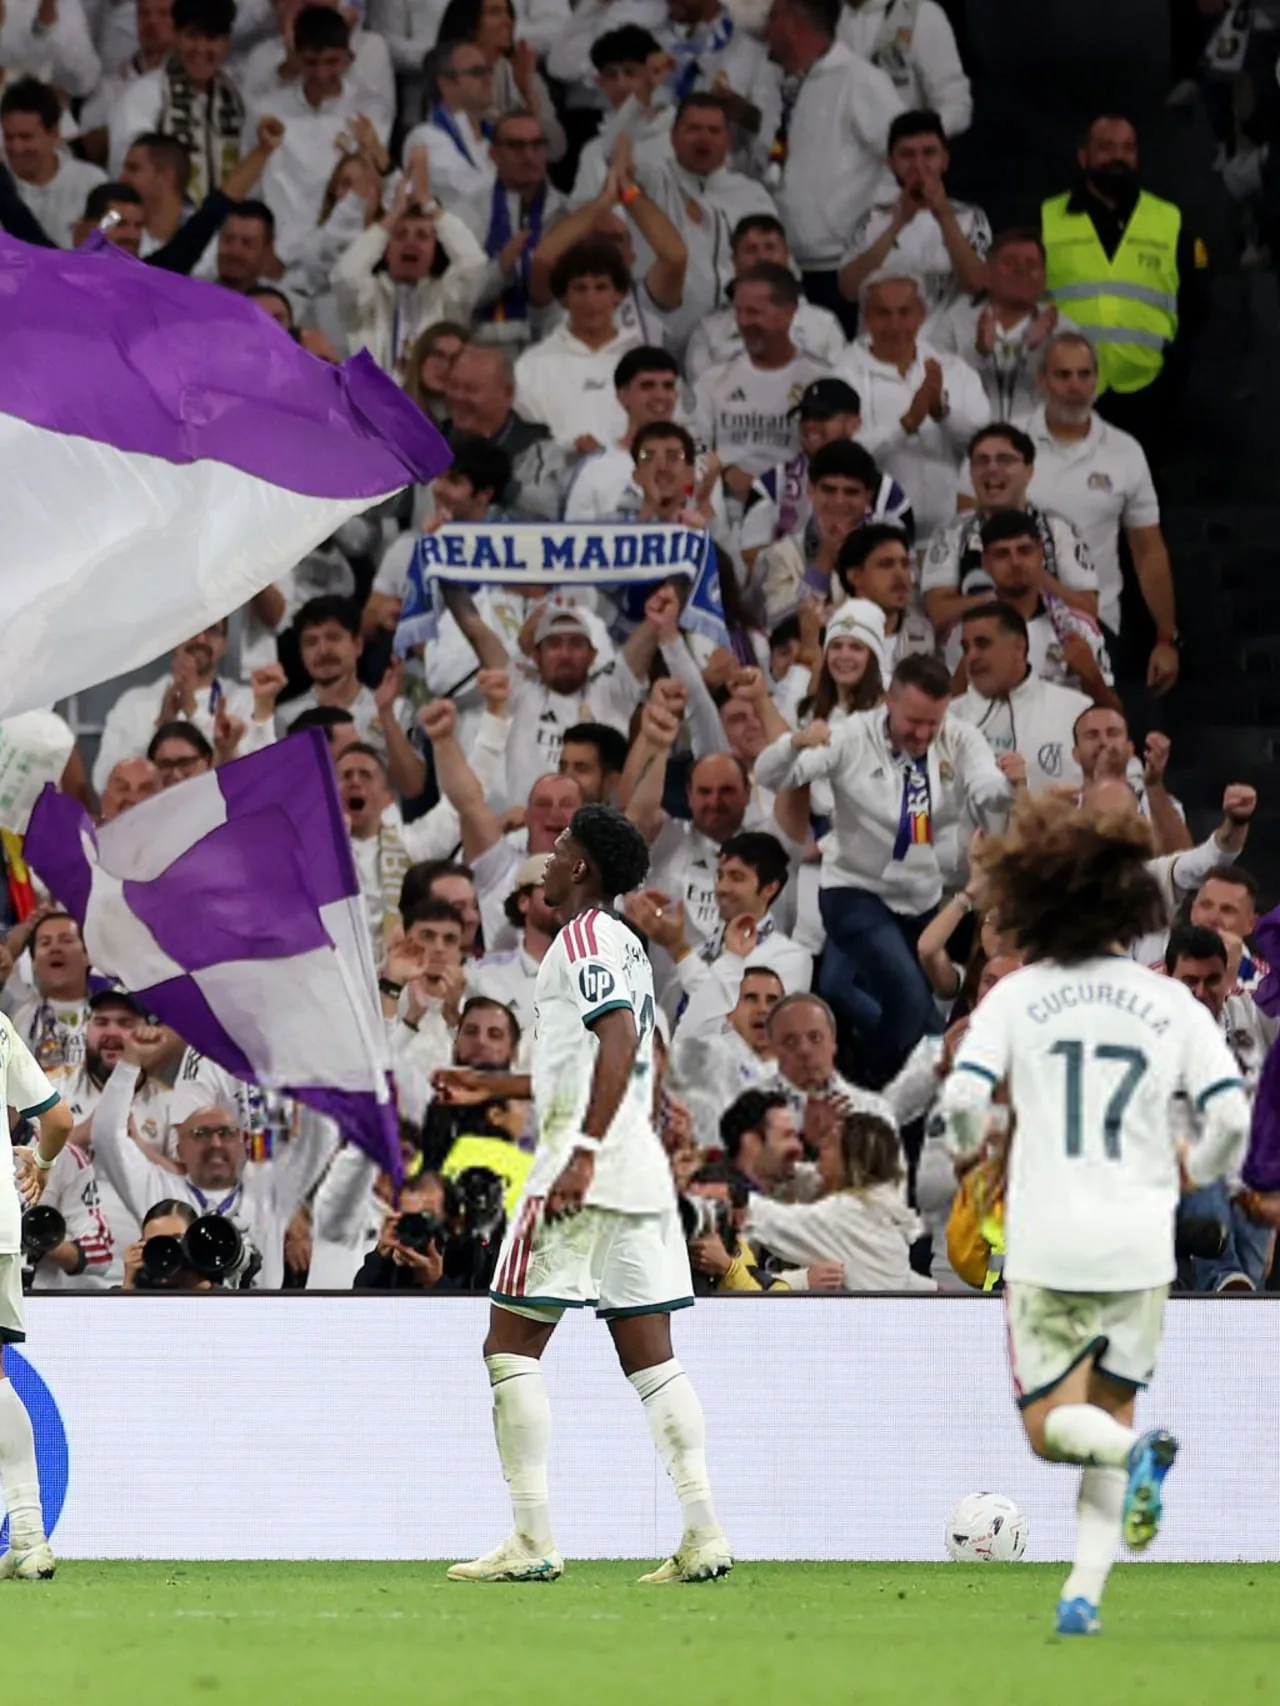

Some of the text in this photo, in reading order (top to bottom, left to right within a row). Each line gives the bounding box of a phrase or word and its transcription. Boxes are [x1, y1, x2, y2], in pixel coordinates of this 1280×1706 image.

[420, 531, 707, 570] REAL MADRID
[583, 964, 612, 1002] hp
[1027, 983, 1172, 1038] CUCURELLA
[1048, 1040, 1149, 1161] 17
